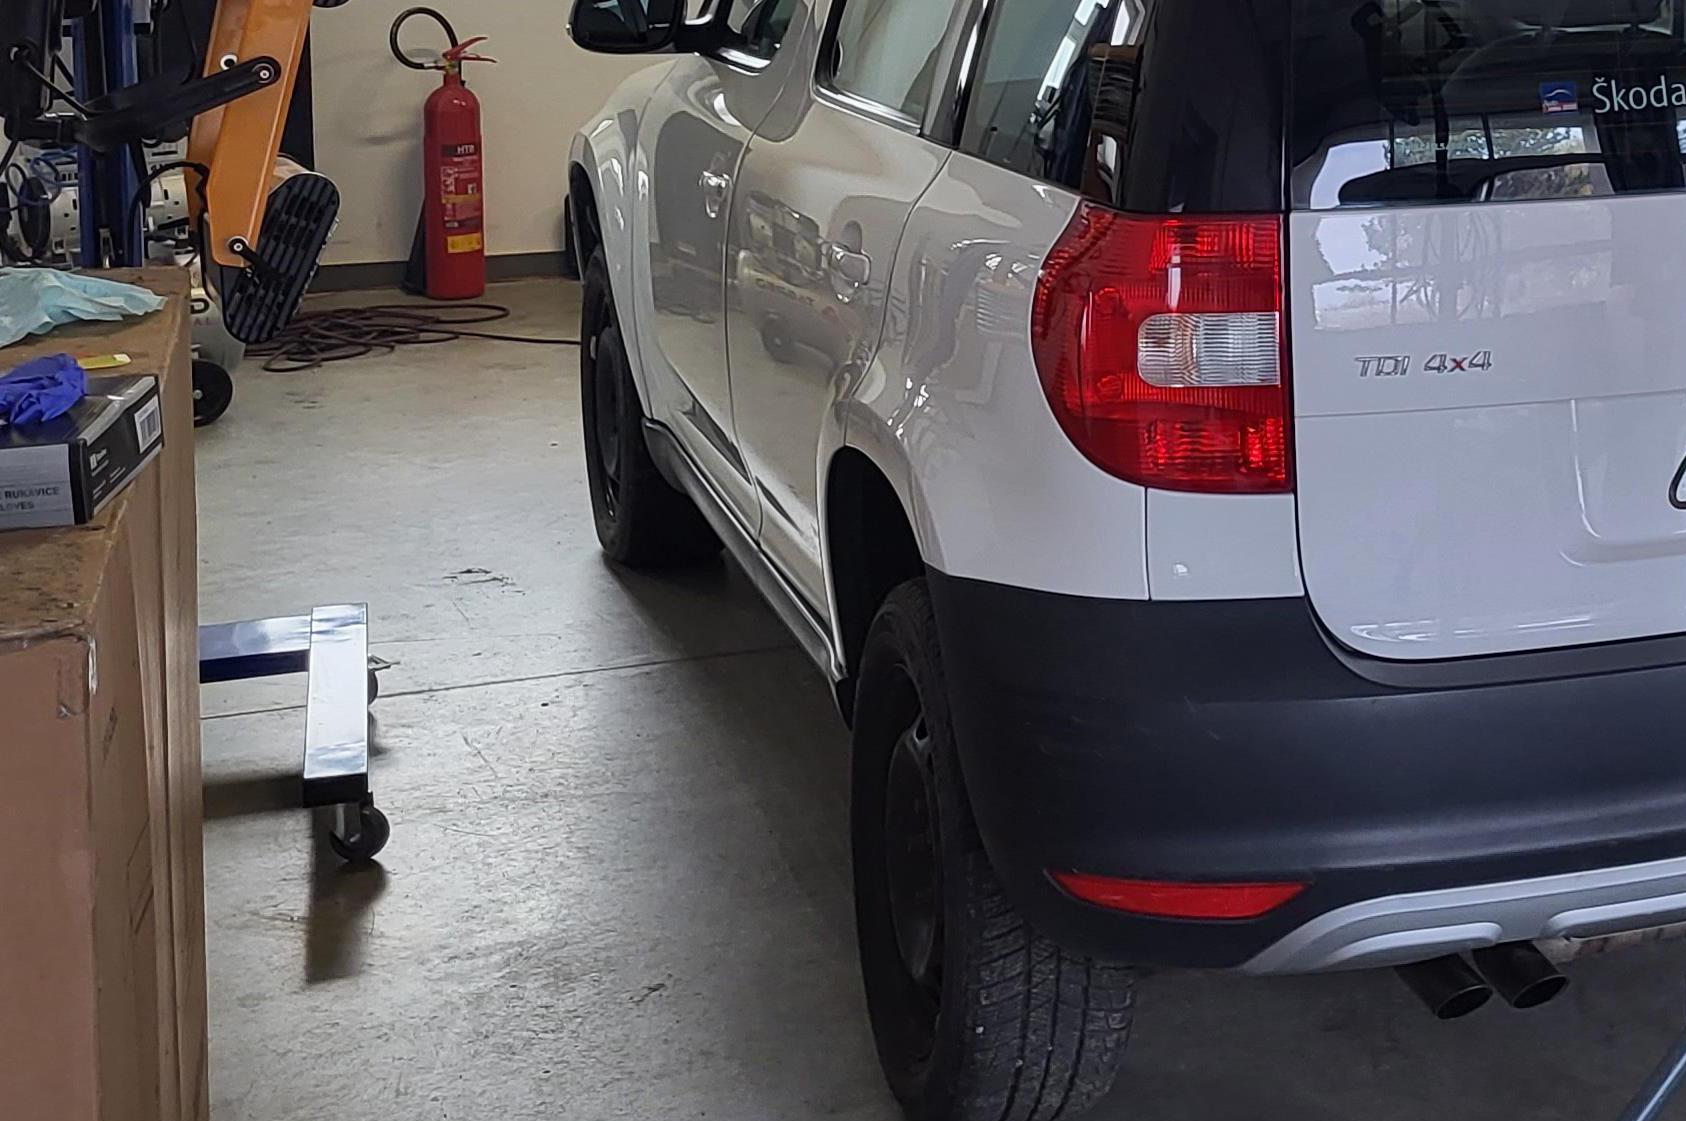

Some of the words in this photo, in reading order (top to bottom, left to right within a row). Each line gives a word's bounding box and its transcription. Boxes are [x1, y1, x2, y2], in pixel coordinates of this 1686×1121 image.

[1354, 355, 1411, 377] TDI
[1423, 350, 1493, 374] 4x4
[0, 501, 35, 512] LOVES
